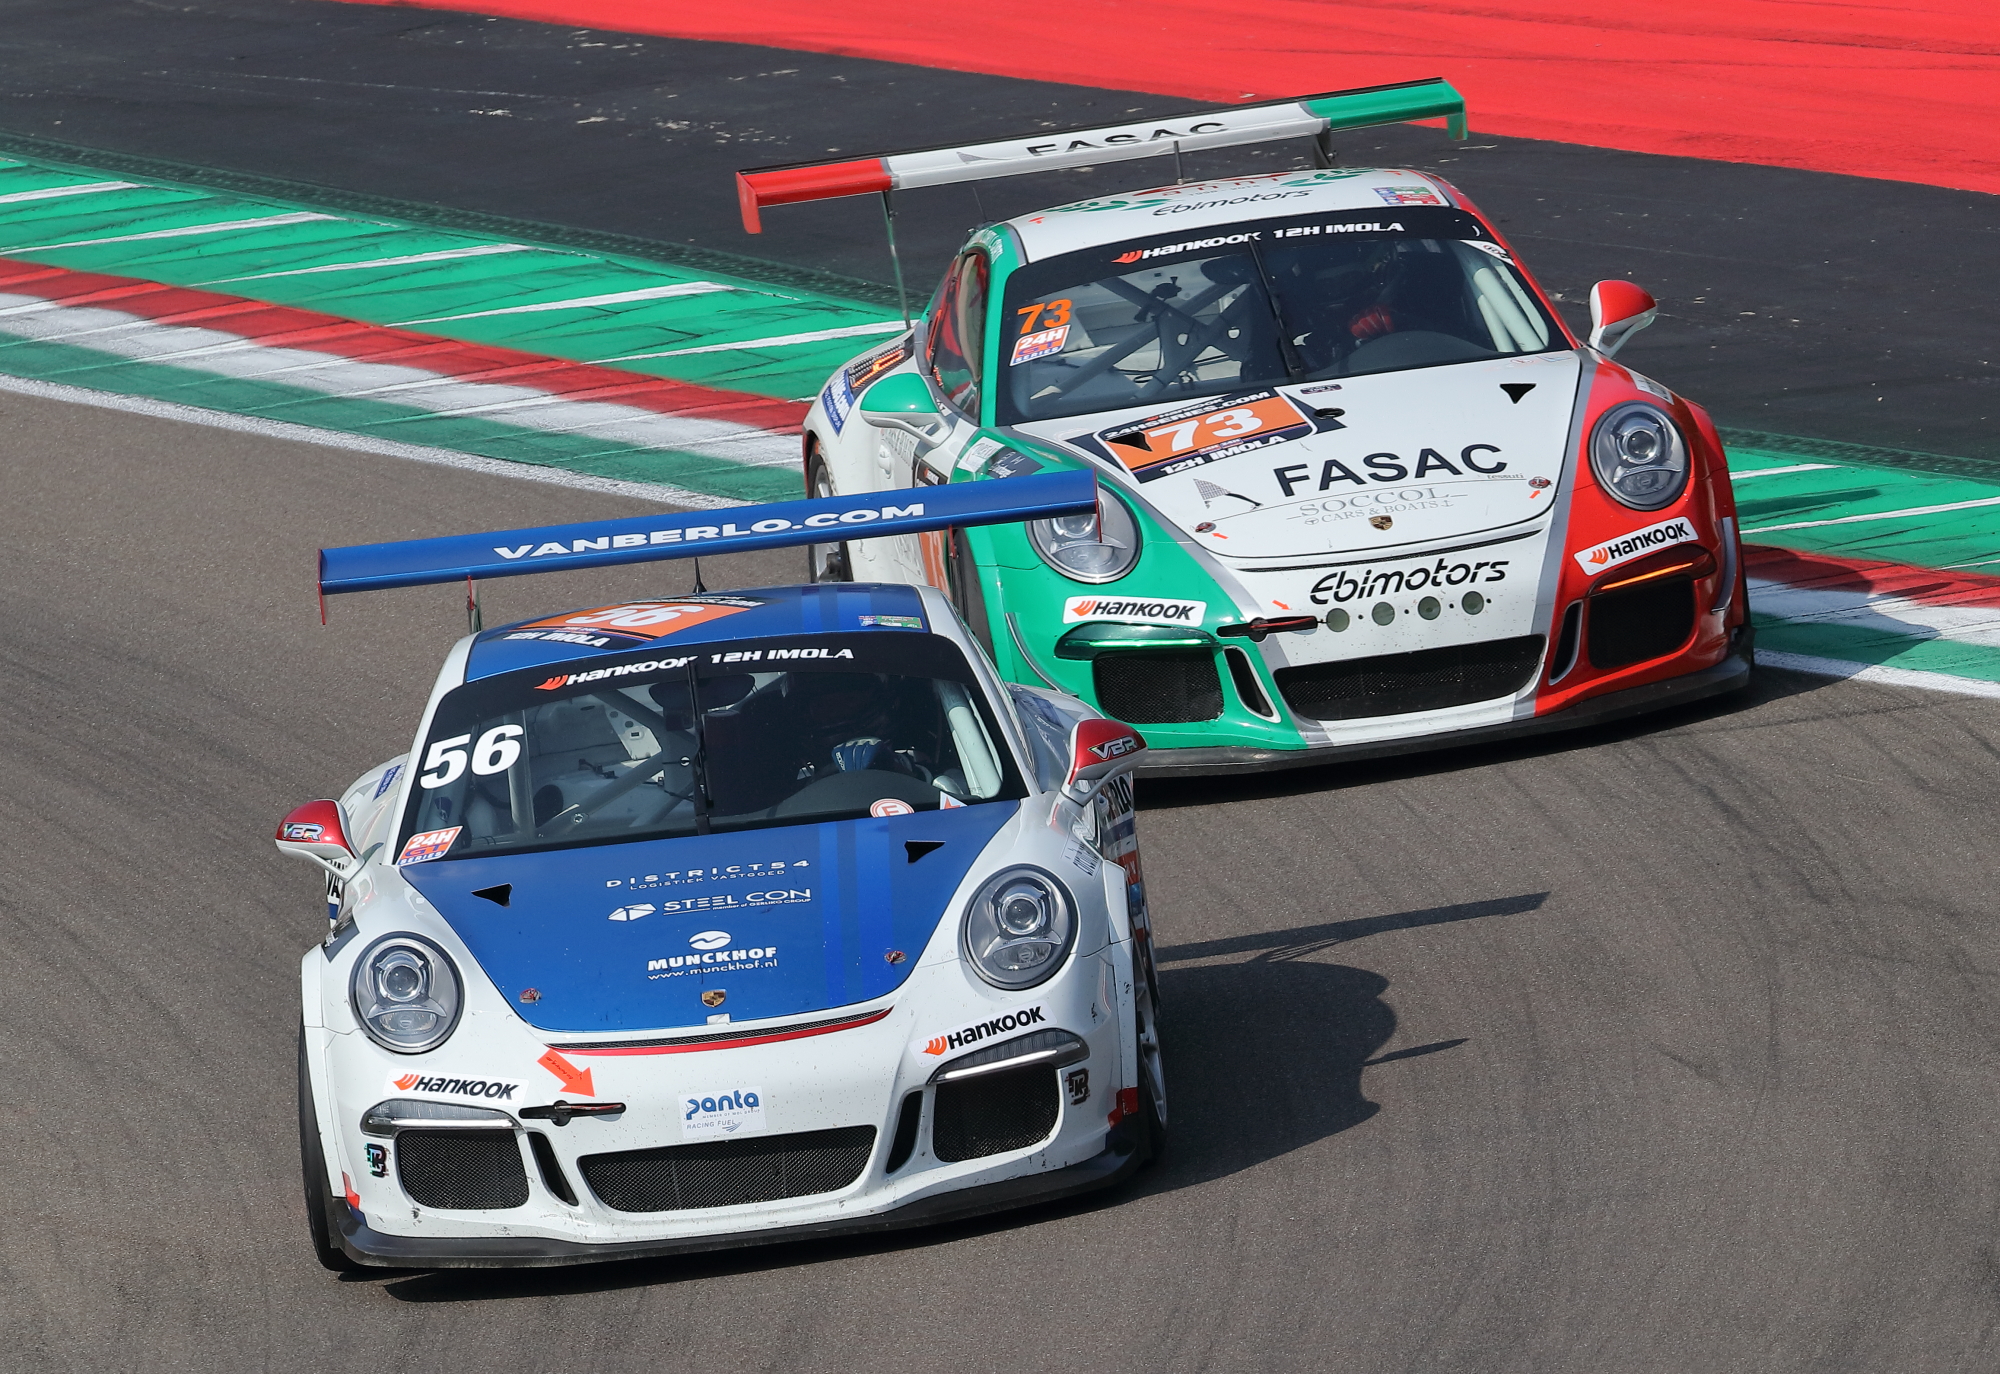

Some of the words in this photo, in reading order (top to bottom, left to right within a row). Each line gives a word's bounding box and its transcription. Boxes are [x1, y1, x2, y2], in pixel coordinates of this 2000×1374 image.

[1025, 122, 1228, 157] FASAC
[1273, 225, 1320, 240] 12H
[1326, 221, 1405, 234] IMOLA
[1017, 299, 1072, 334] 73
[1019, 328, 1065, 350] 24H
[1014, 346, 1061, 363] SERIES
[1147, 408, 1263, 452] 73
[1160, 456, 1206, 475] 12H
[1208, 435, 1288, 460] IMOLA
[1273, 443, 1508, 497] FASAC
[1486, 473, 1525, 481] tessuti
[1299, 487, 1450, 517] SOCCOL
[1321, 509, 1366, 524] CARS
[1368, 507, 1381, 517] &
[1383, 500, 1438, 513] BOATS
[493, 503, 926, 560] VANBERLO.COM
[1309, 558, 1510, 604] Ebimotors
[564, 604, 705, 627] 56
[710, 650, 762, 664] 12H
[767, 647, 854, 661] IMOLA
[420, 724, 524, 789] 56
[1088, 735, 1141, 761] VBR
[282, 822, 325, 842] VBR
[407, 830, 456, 850] 24H
[400, 850, 445, 865] SERIES
[405, 843, 449, 857] GT
[630, 877, 704, 890] LOGISTIEK
[711, 869, 786, 882] VASTGOED
[647, 946, 778, 971] MUNCKHOF
[647, 959, 778, 981] www.munckhof.nl
[685, 1089, 760, 1121] panta
[686, 1121, 715, 1130] RACING
[717, 1119, 736, 1127] FUEL
